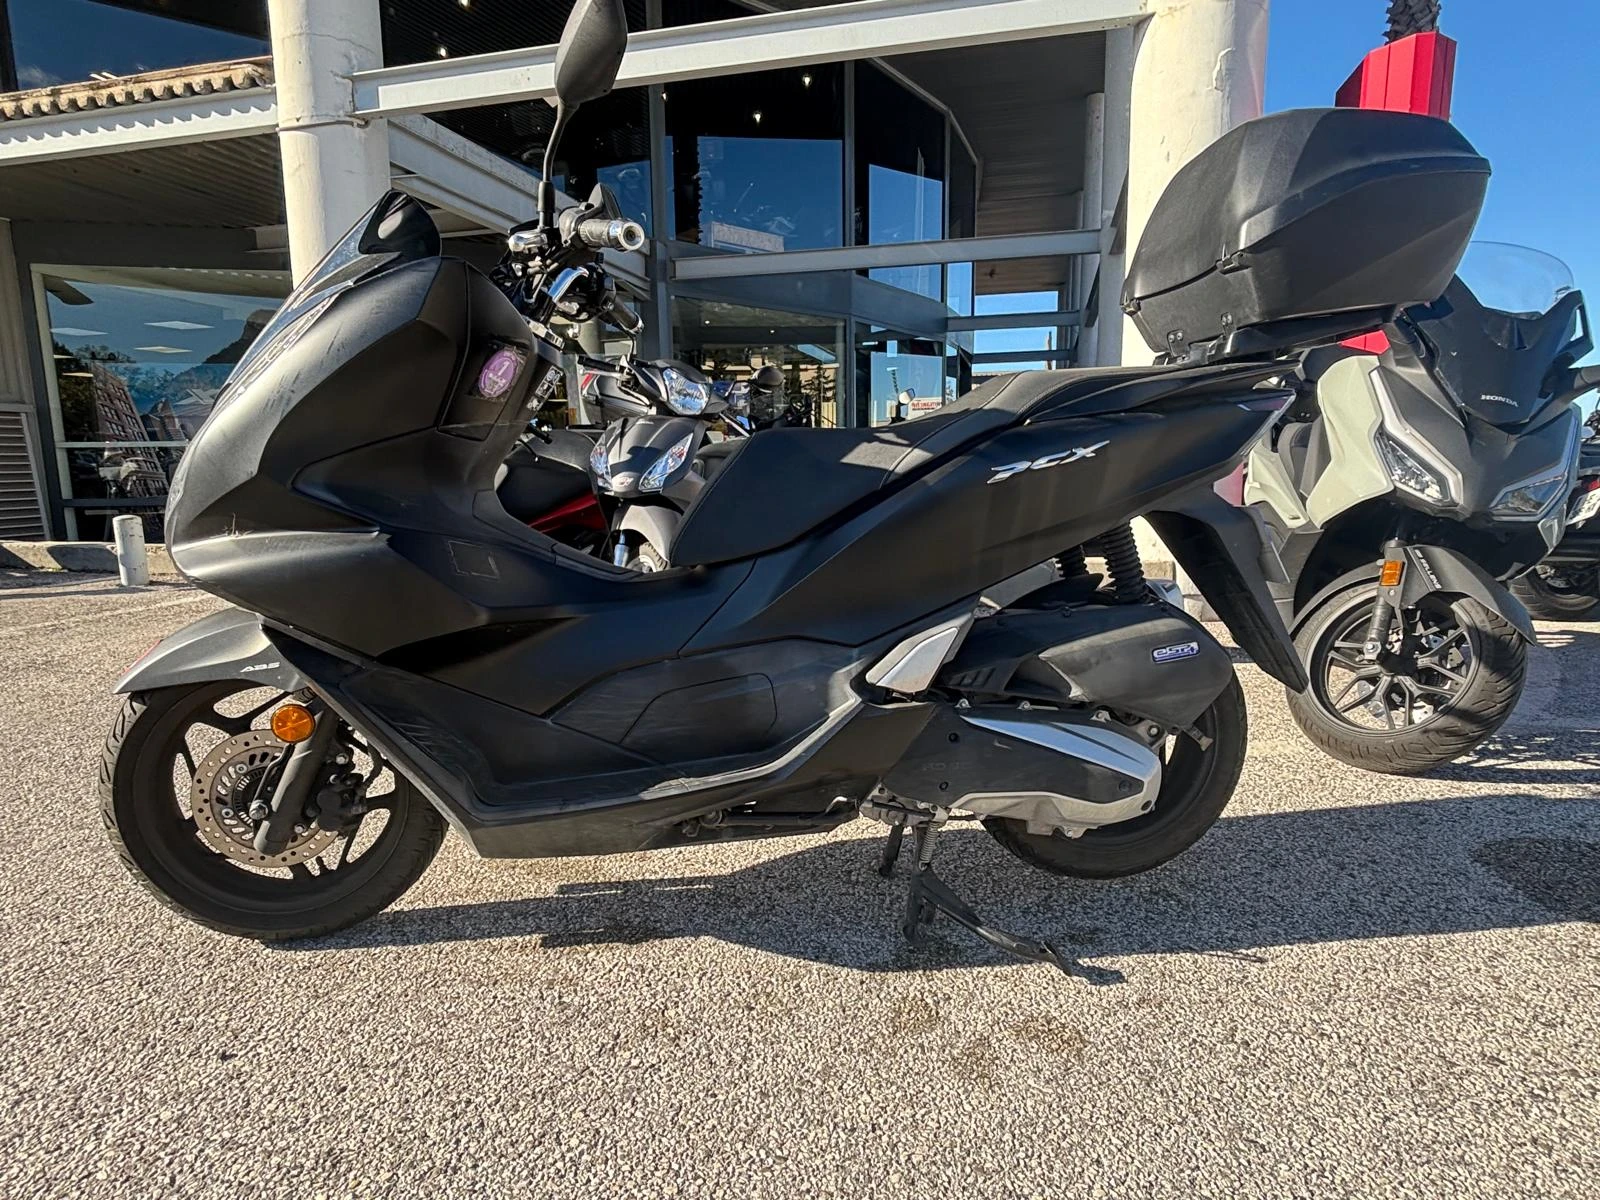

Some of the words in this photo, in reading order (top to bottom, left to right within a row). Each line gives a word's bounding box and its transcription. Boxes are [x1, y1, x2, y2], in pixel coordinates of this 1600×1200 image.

[1480, 394, 1519, 408] HONDA
[986, 440, 1111, 484] PCX
[239, 661, 281, 673] ABS
